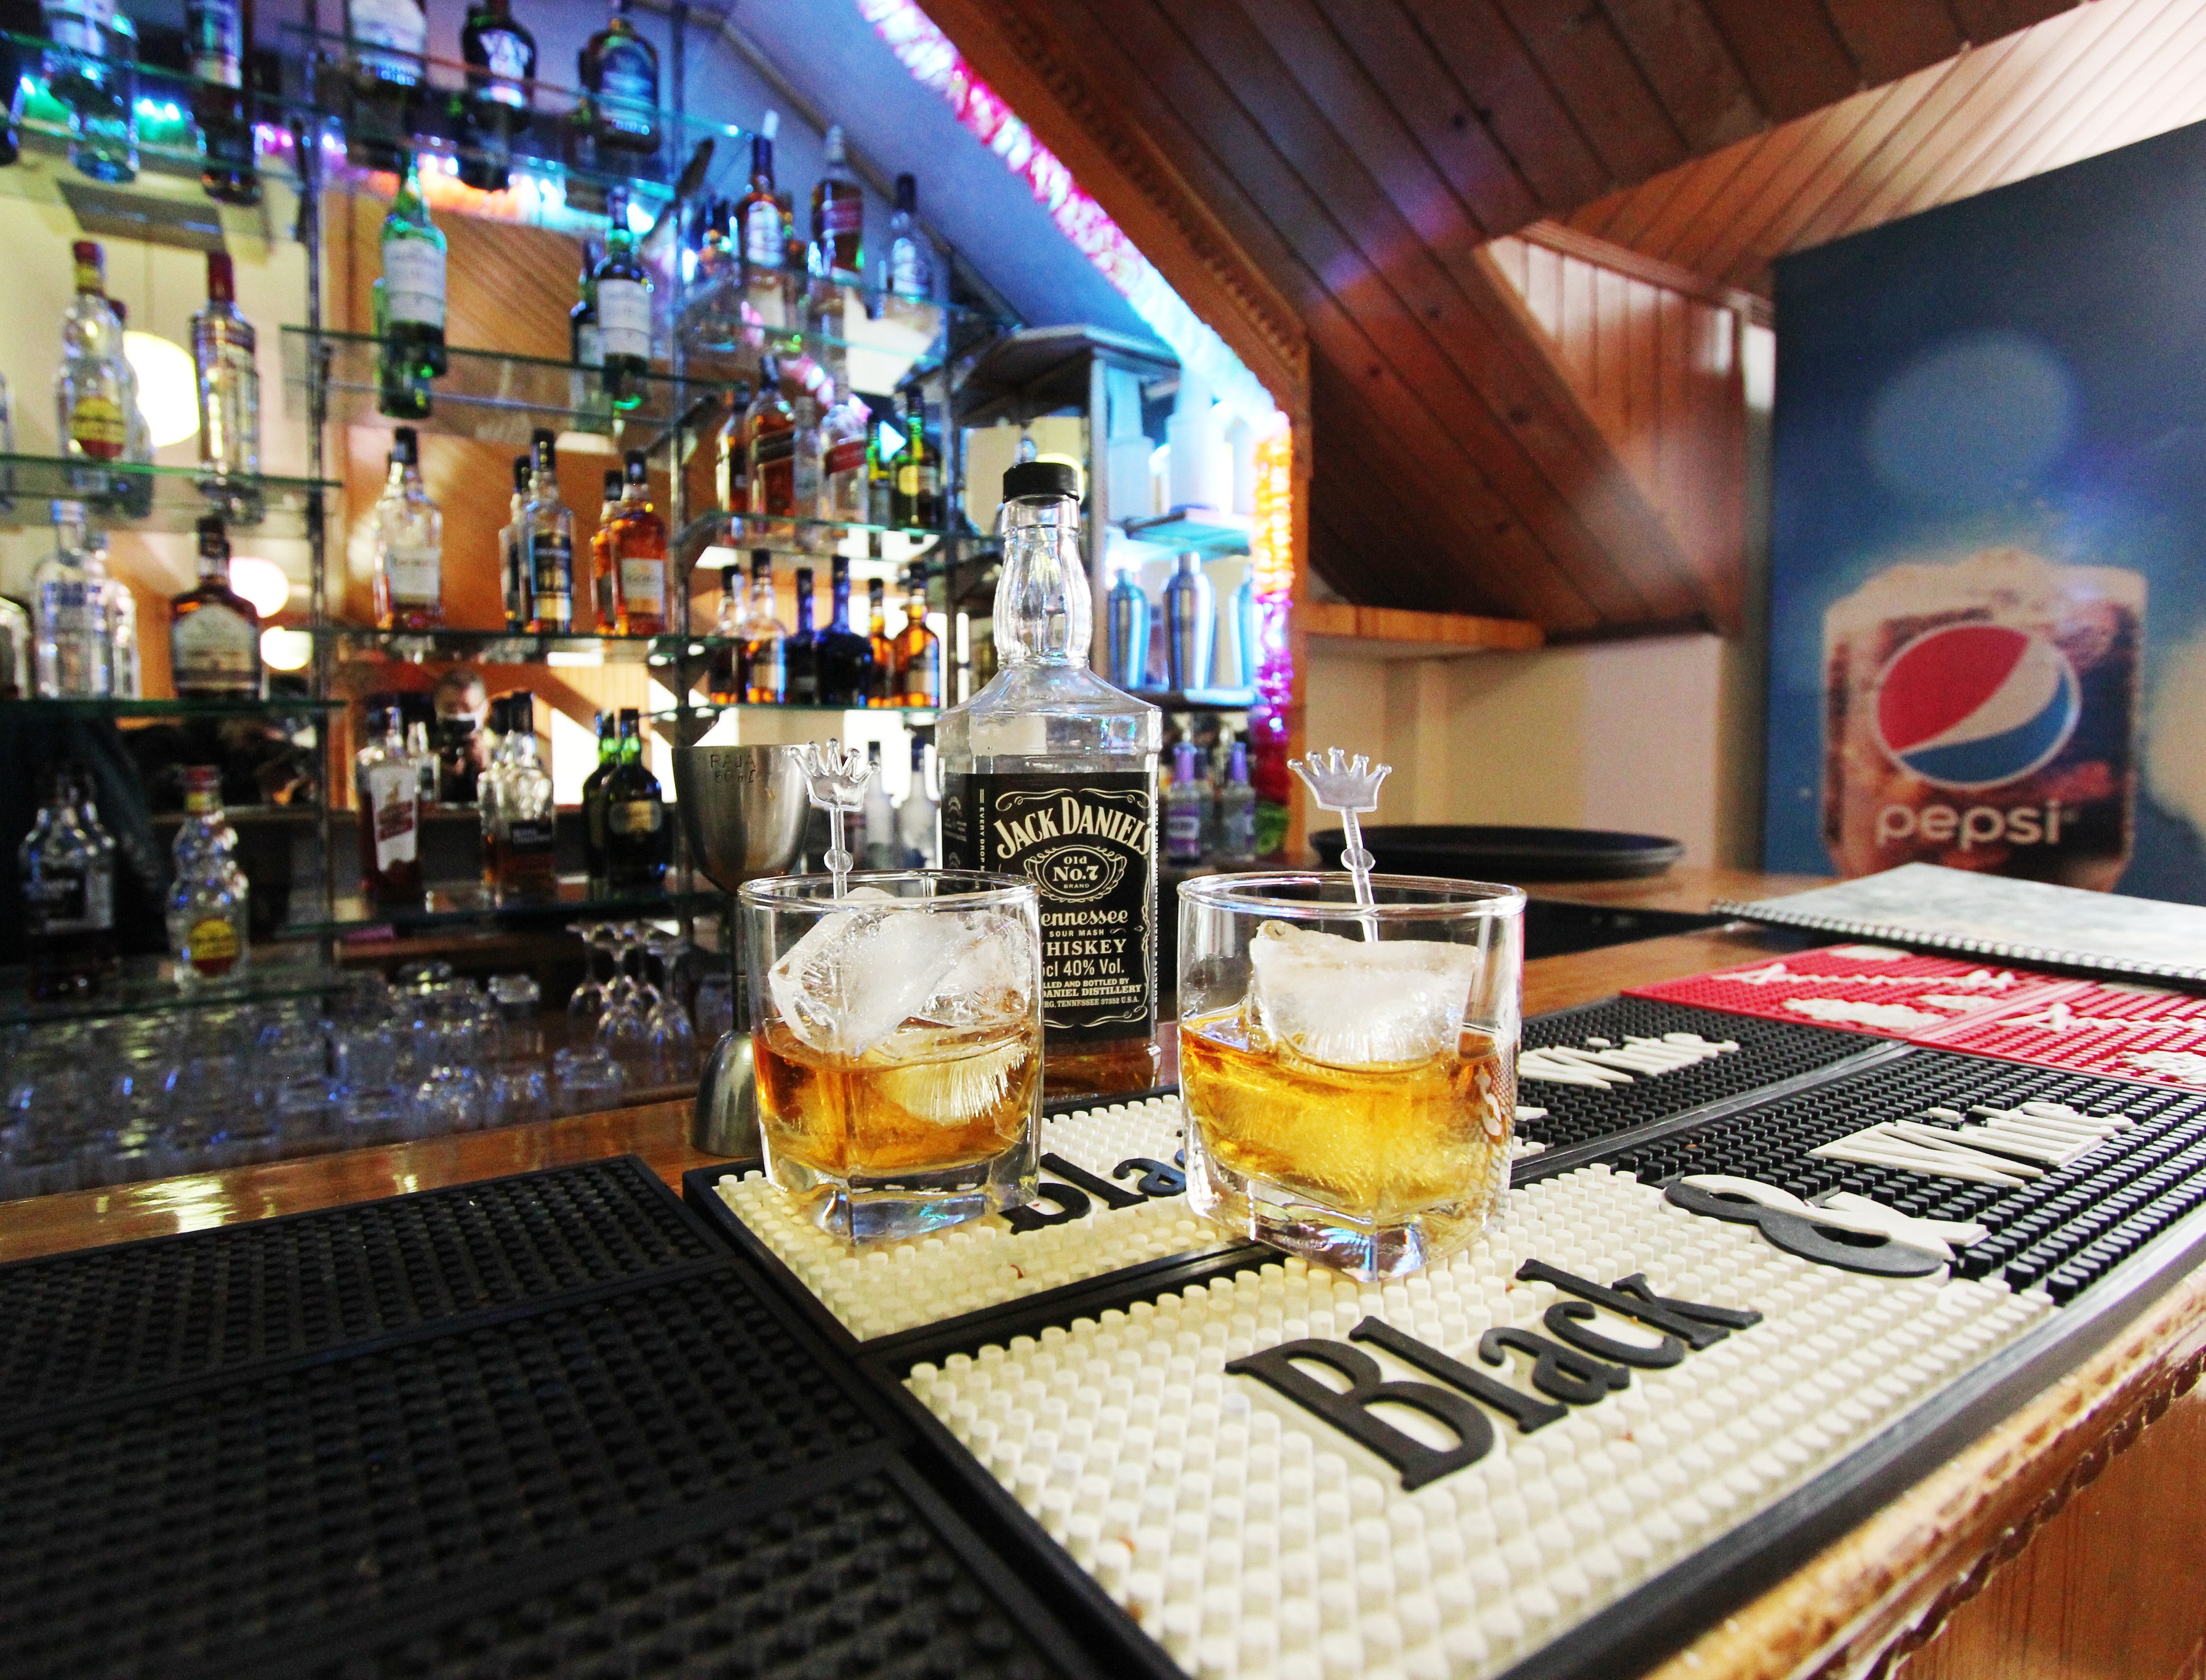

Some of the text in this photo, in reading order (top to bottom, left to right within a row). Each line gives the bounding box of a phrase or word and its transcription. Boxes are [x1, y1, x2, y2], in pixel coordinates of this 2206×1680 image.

[1874, 798, 2062, 850] pepsi
[993, 808, 1060, 859] JACK
[1063, 856, 1088, 865] Old
[1053, 865, 1099, 882] No.7
[1041, 910, 1128, 927] ennessee
[1049, 929, 1074, 938] SOUR
[1042, 938, 1127, 957] HISKEY
[1063, 959, 1095, 976] 40%
[1099, 958, 1125, 975] Vol.
[1081, 984, 1142, 996] DISTILLERY
[1083, 979, 1117, 987] BOTTLED
[1057, 998, 1100, 1008] TENNESSEE
[1808, 1100, 2140, 1190] White
[1225, 1257, 1764, 1492] Black
